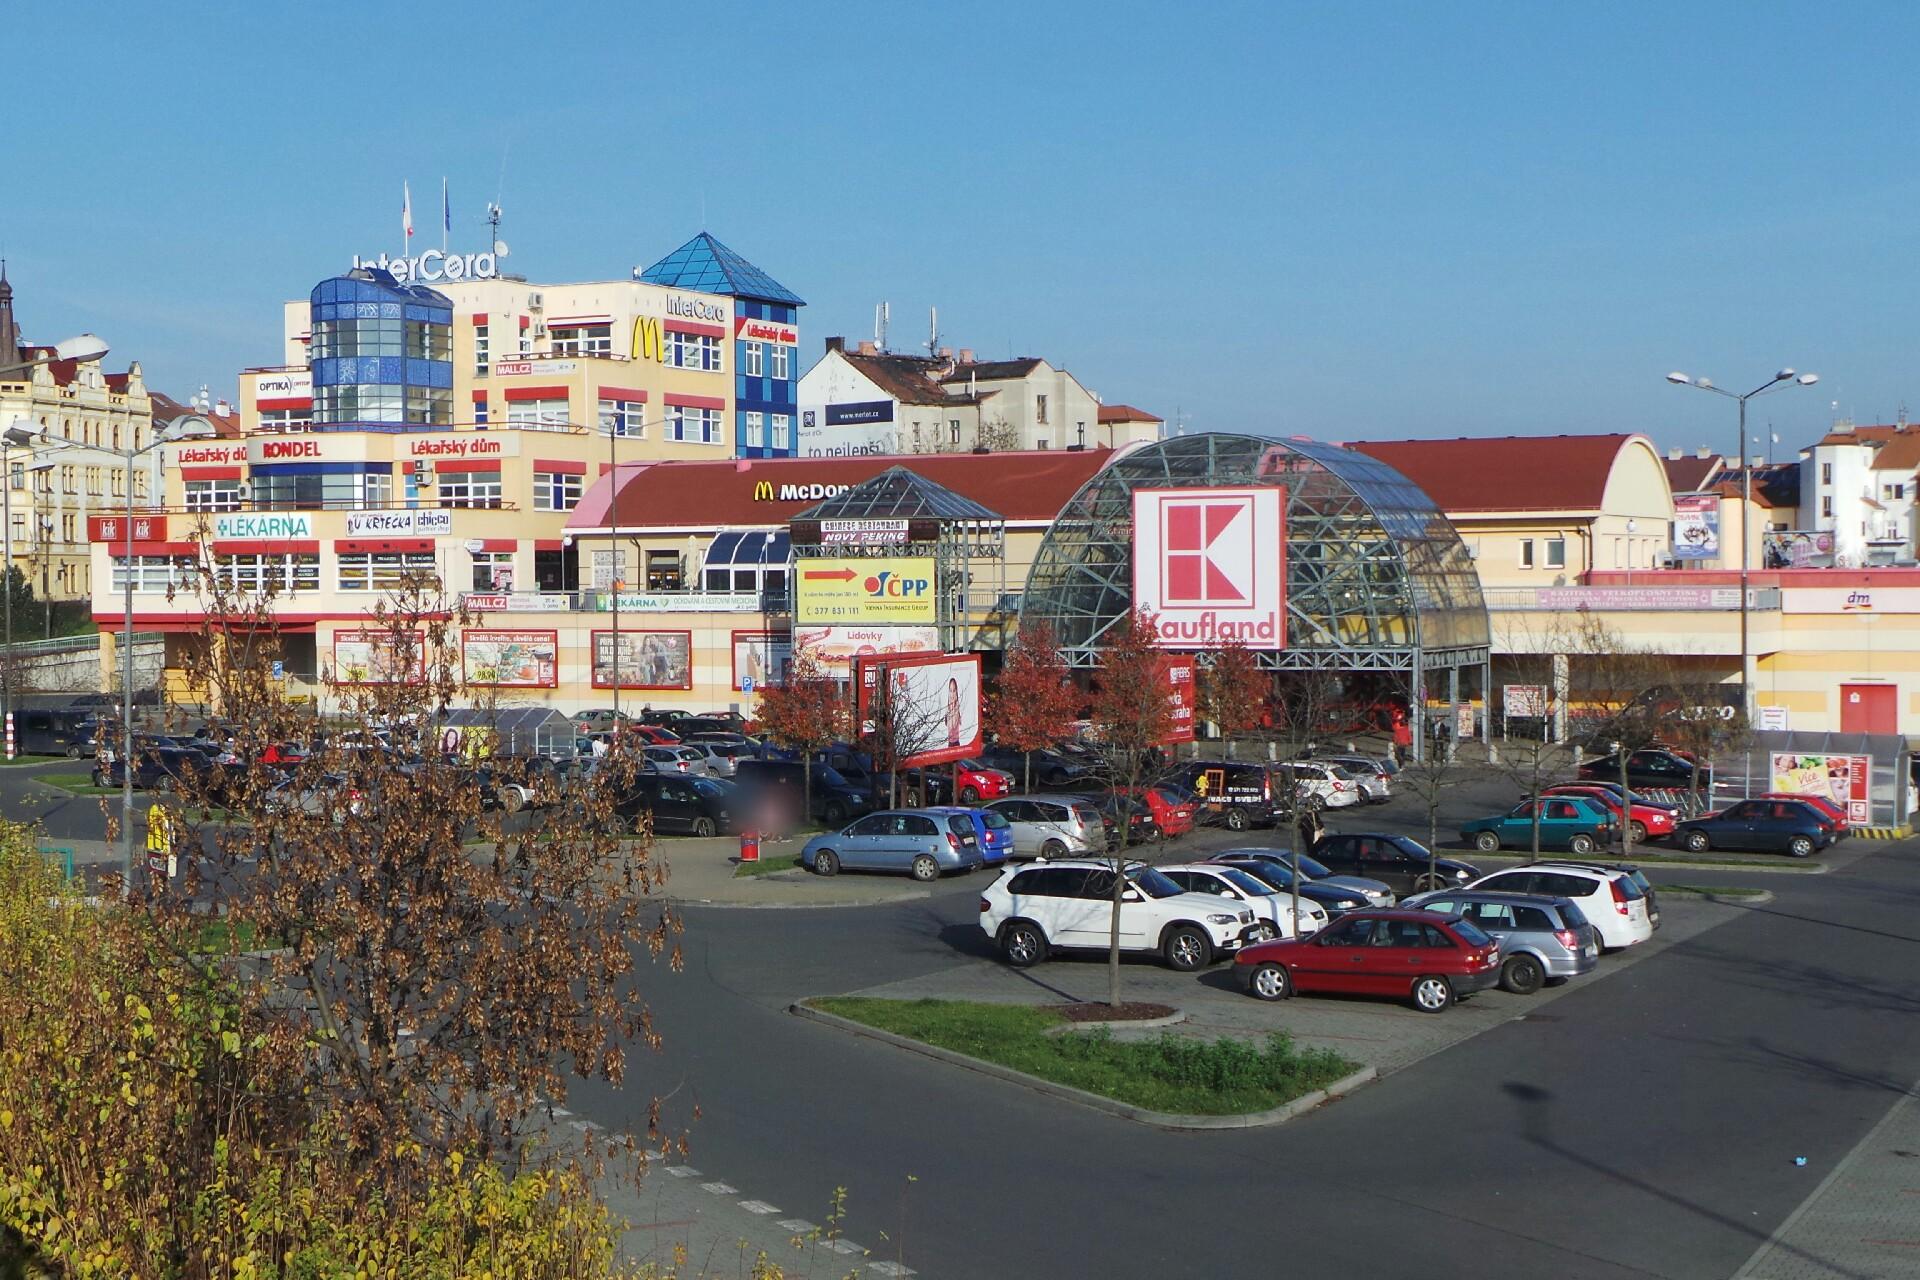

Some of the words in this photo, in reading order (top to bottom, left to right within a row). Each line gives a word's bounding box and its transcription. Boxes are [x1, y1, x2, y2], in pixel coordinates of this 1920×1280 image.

[497, 363, 531, 374] MALL.CZ
[259, 381, 289, 391] OPTIKA
[263, 442, 322, 458] RONDEL
[411, 439, 467, 456] Lékařský
[470, 438, 500, 453] dům
[808, 445, 822, 458] to
[179, 446, 230, 464] Lékařský
[233, 445, 248, 461] dů
[417, 511, 449, 527] chicco
[229, 515, 308, 537] LÉKÁRNA
[825, 521, 856, 531] CHINESE
[858, 521, 905, 531] RESTAURANT
[824, 531, 857, 541] NOVÝ
[860, 532, 906, 541] PEKING
[887, 574, 928, 597] ČPP
[467, 597, 506, 608] MALL.CZ
[1847, 591, 1870, 604] dm
[814, 607, 828, 615] 377
[848, 607, 859, 615] 111
[1141, 611, 1275, 639] Kaufland
[469, 634, 489, 642] Skvělá
[513, 634, 533, 642] skvělá
[534, 634, 550, 642] cena!
[847, 631, 883, 642] Lidovky
